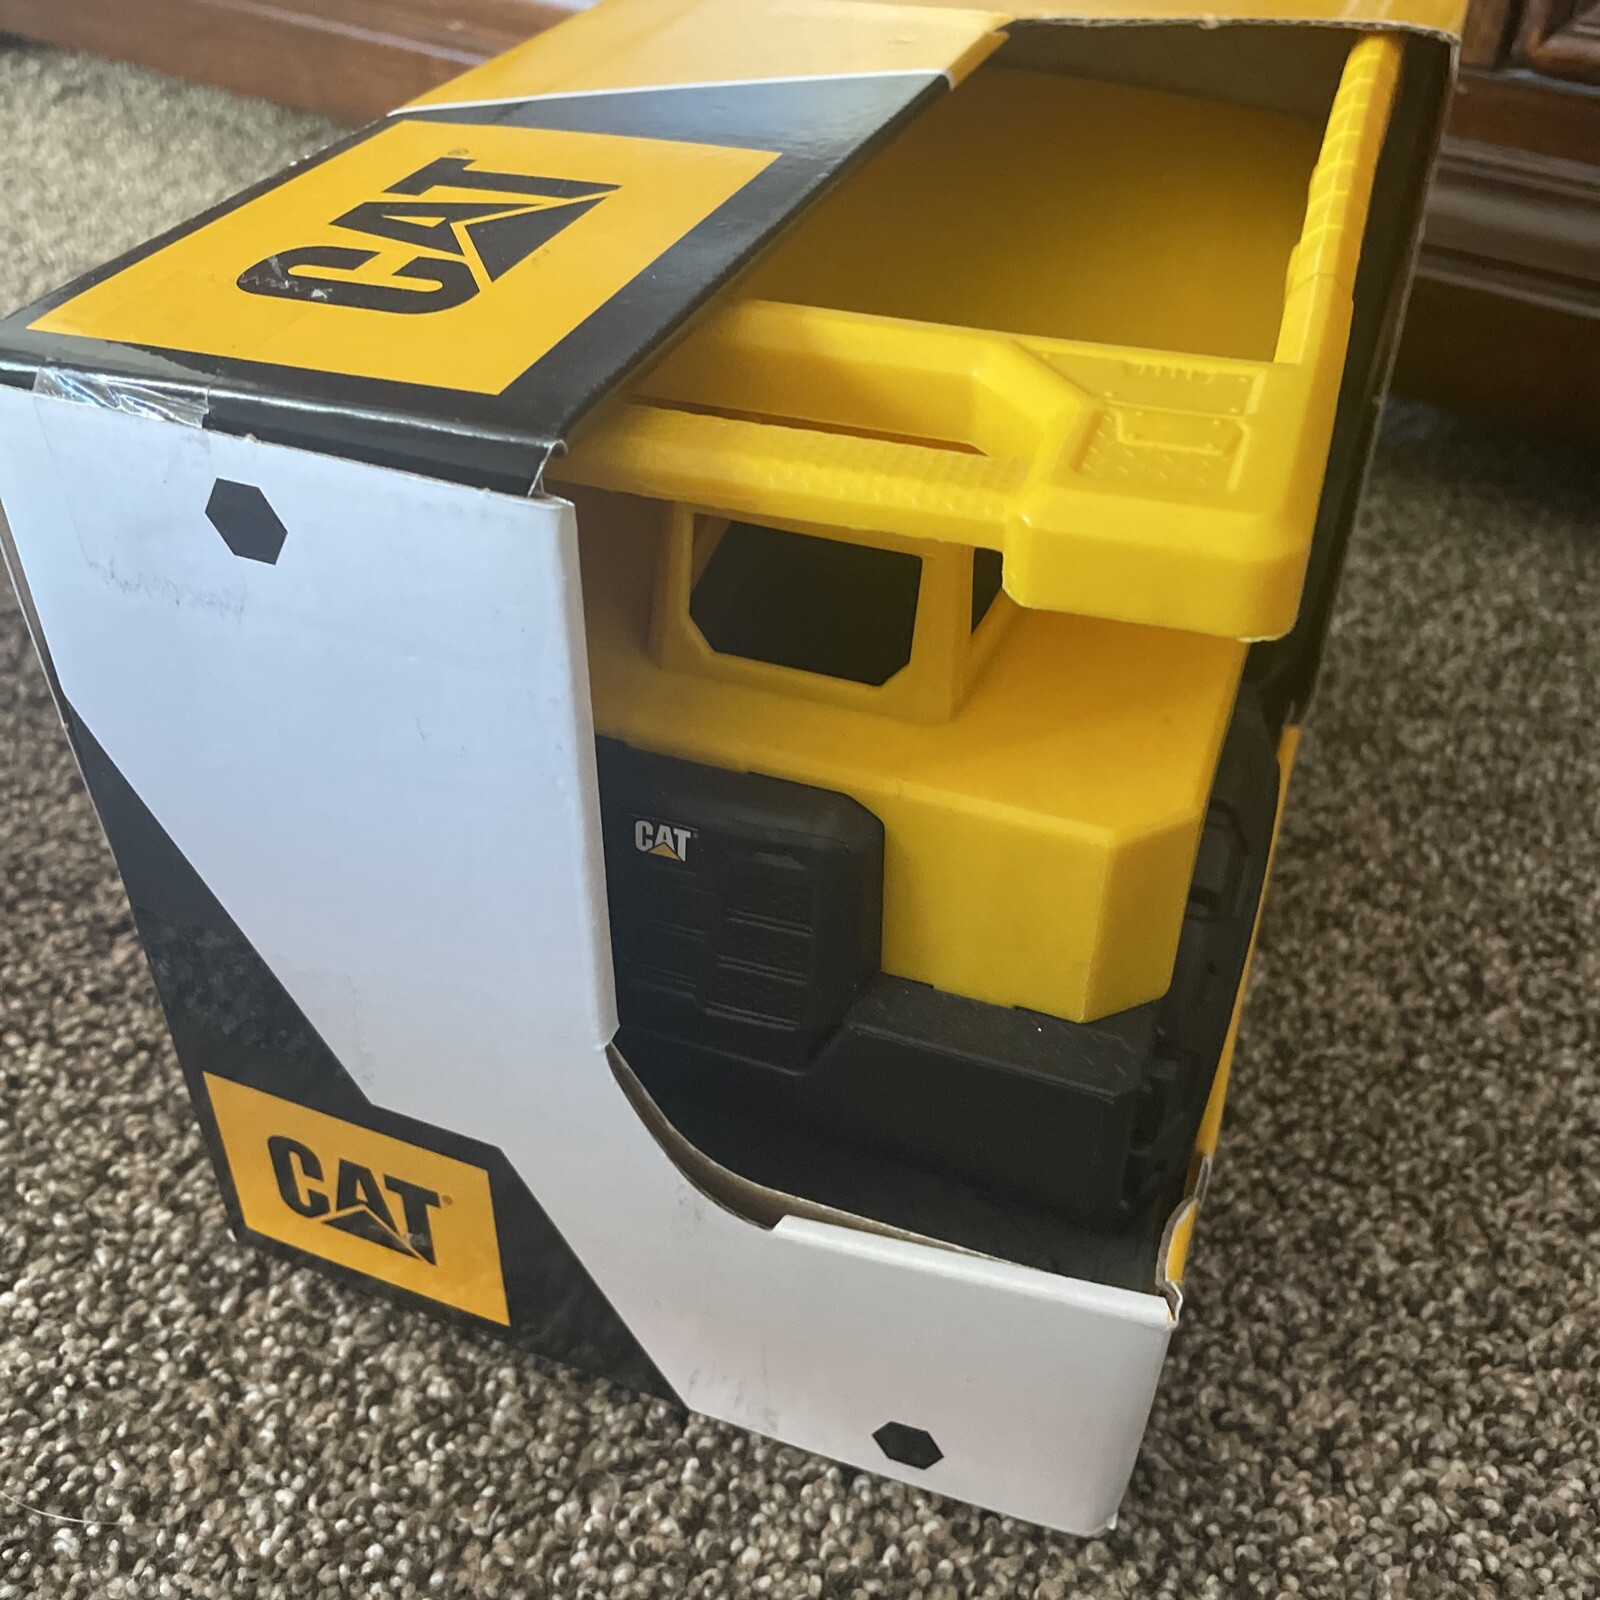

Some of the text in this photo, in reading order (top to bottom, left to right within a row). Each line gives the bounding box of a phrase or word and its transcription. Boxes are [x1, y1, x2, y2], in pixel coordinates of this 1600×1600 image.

[236, 156, 623, 315] CAT
[634, 820, 692, 862] CAT
[266, 1134, 442, 1267] CAT
